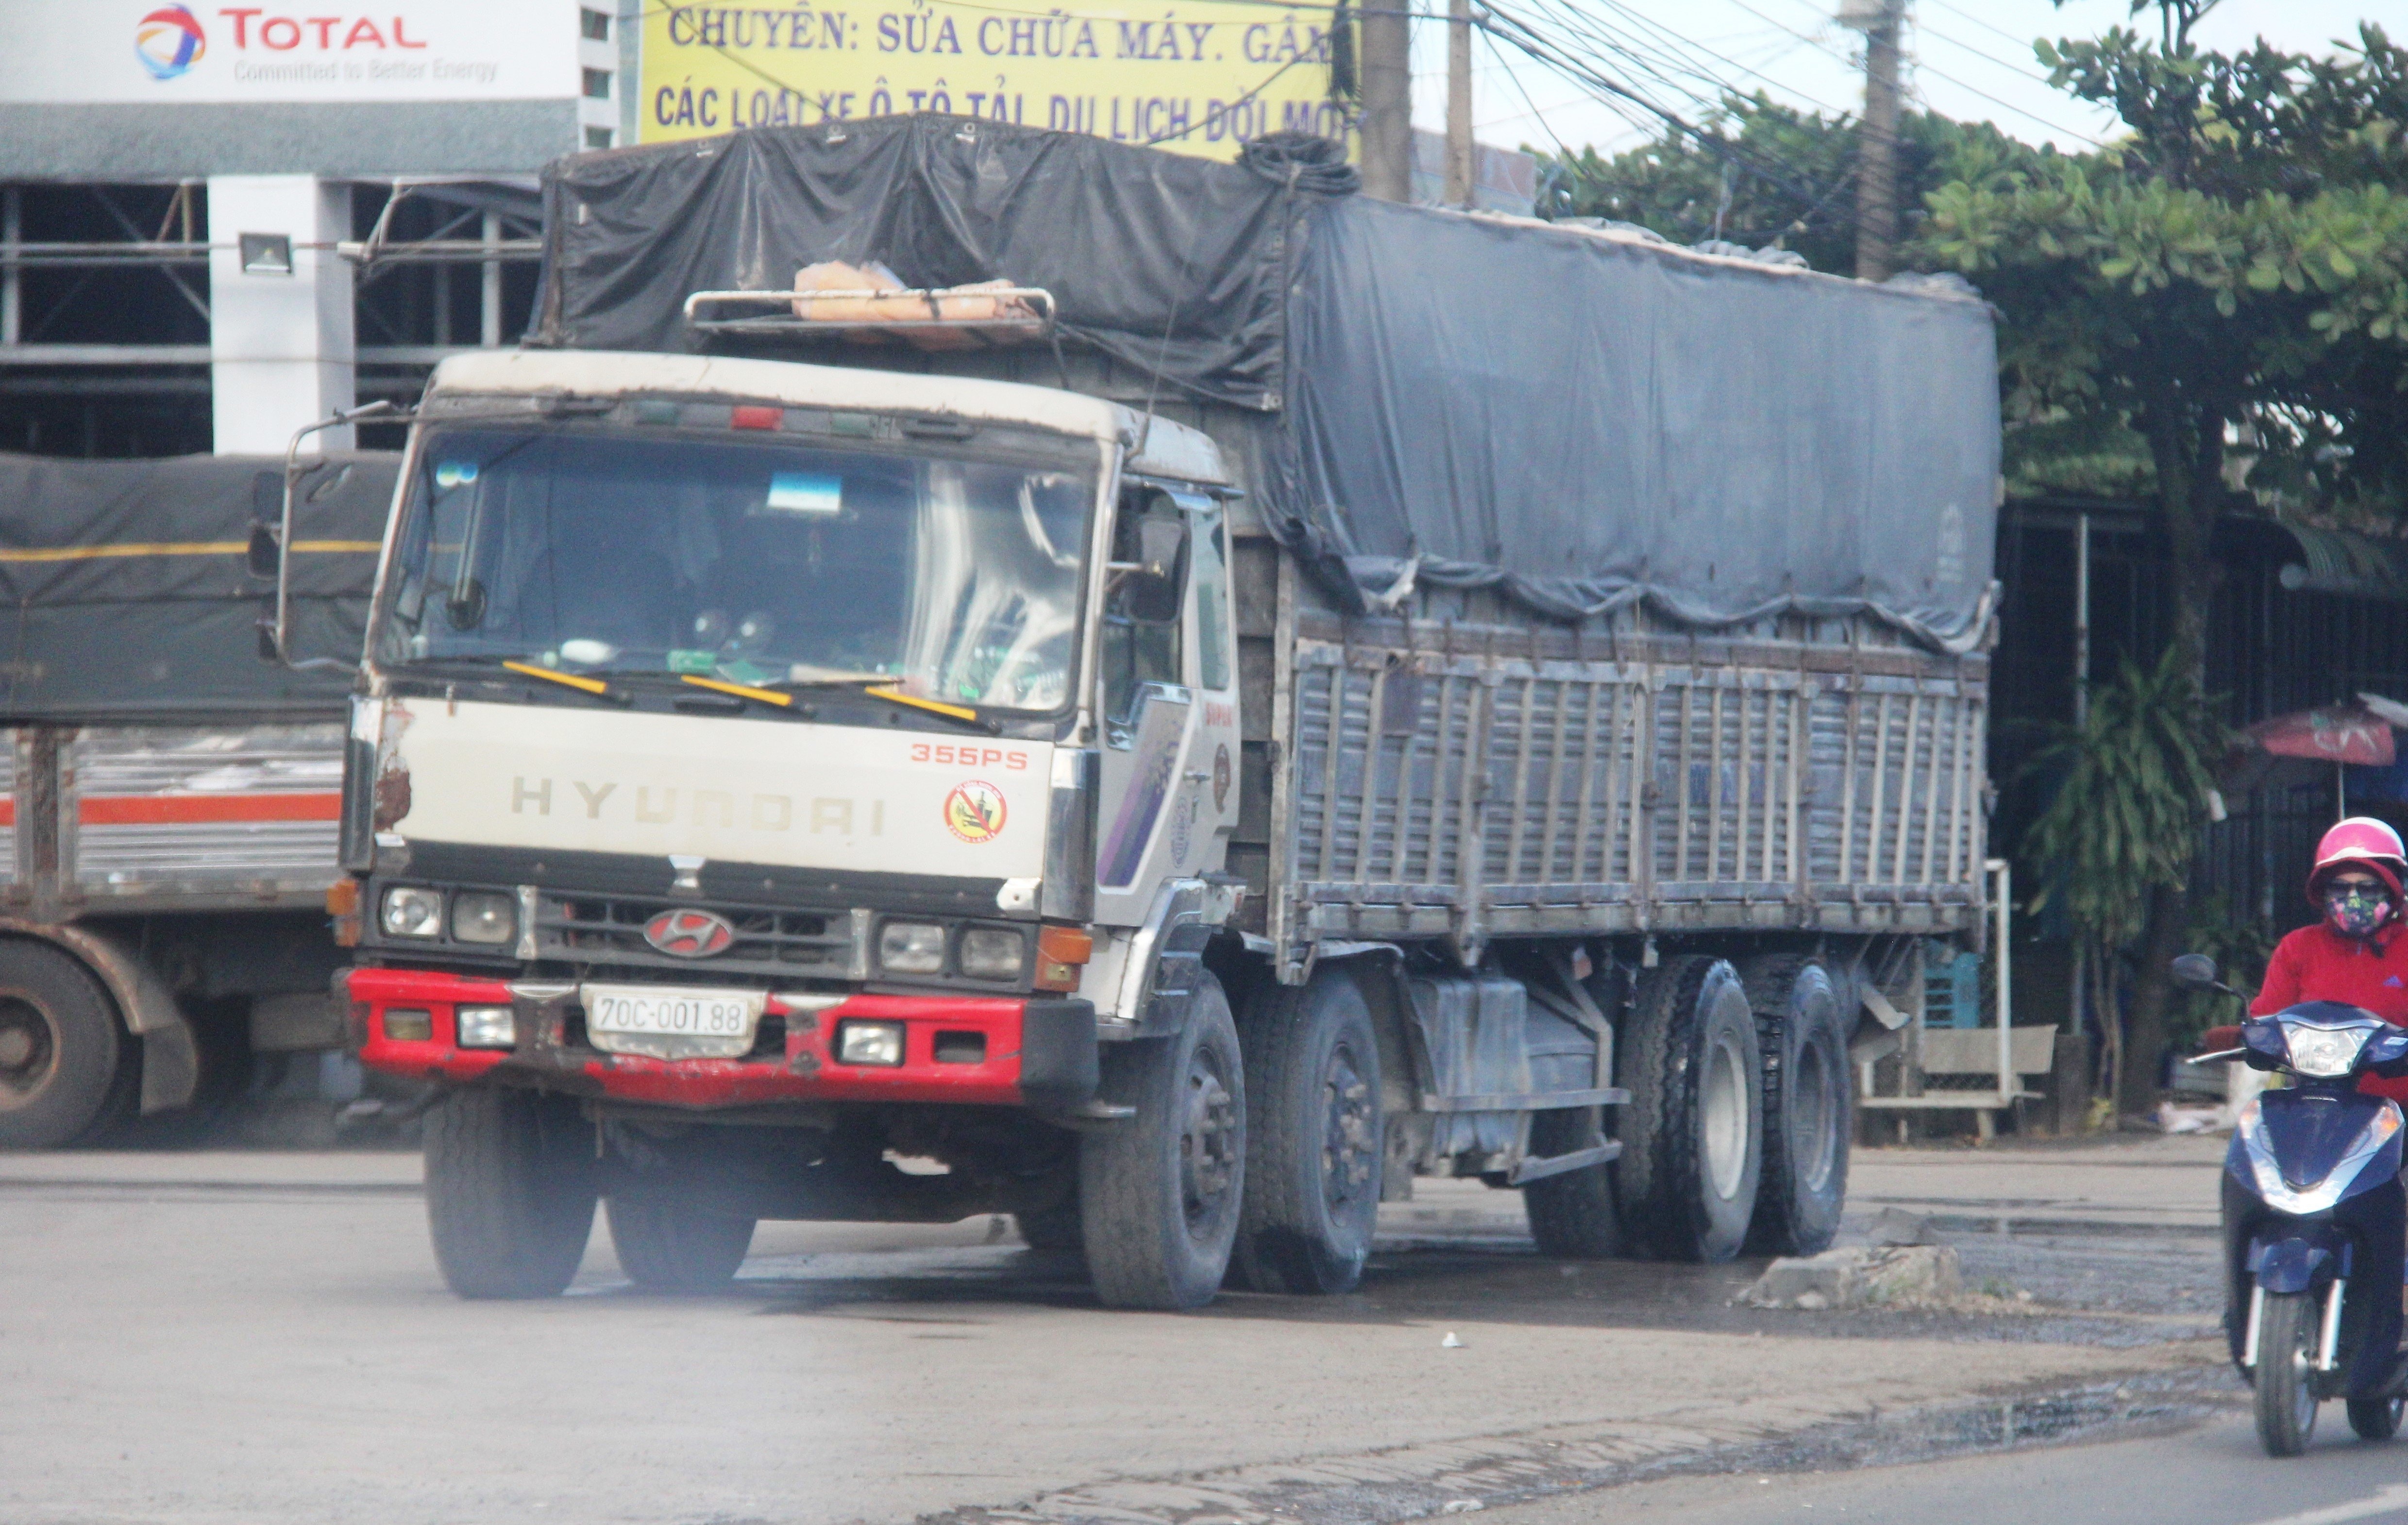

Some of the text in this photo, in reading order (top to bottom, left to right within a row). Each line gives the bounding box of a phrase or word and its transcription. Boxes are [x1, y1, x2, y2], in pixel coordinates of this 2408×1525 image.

[218, 8, 427, 50] TOTAL
[876, 0, 962, 53] SỬA
[234, 57, 498, 83] Committed to Better Energy
[655, 75, 718, 127] CÁC
[911, 743, 1028, 770] 355PS
[511, 777, 886, 837] HYUNDAI
[600, 997, 741, 1032] 70C-001.88
